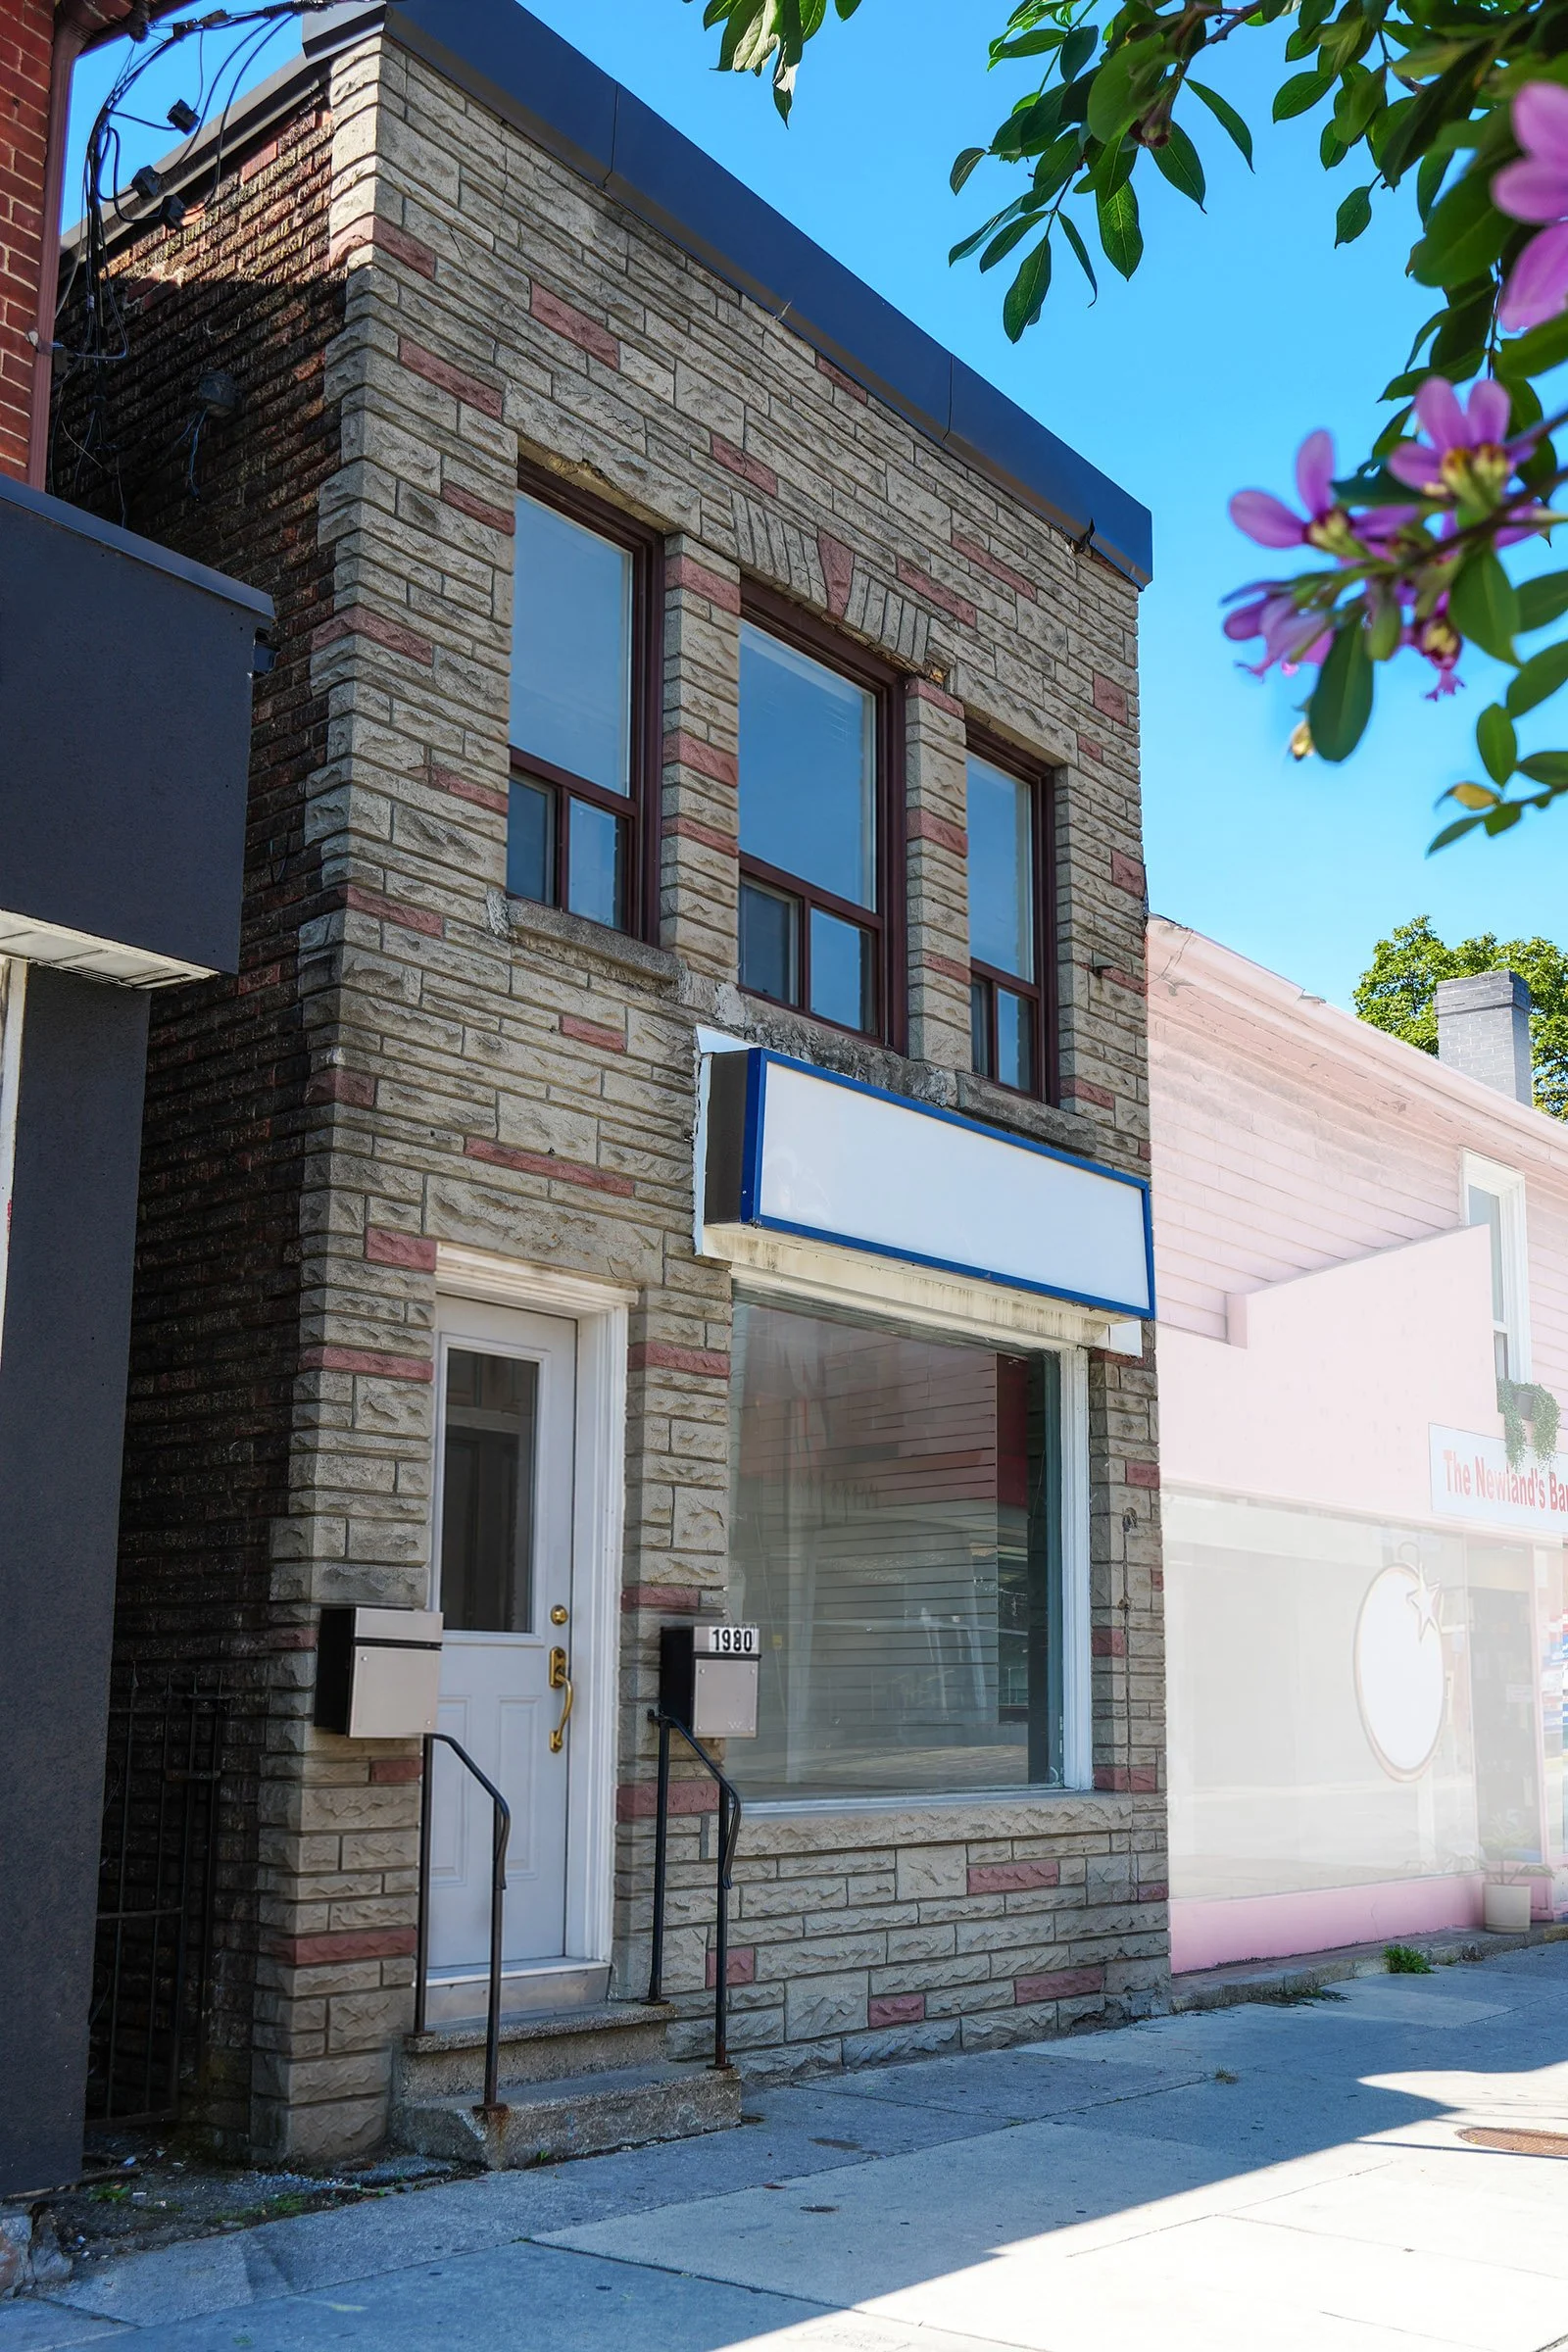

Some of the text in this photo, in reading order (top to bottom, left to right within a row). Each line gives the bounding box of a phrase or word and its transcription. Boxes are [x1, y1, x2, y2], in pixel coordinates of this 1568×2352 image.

[1443, 1449, 1471, 1495] The
[1475, 1455, 1546, 1509] Newland's
[712, 1629, 753, 1652] 1980
